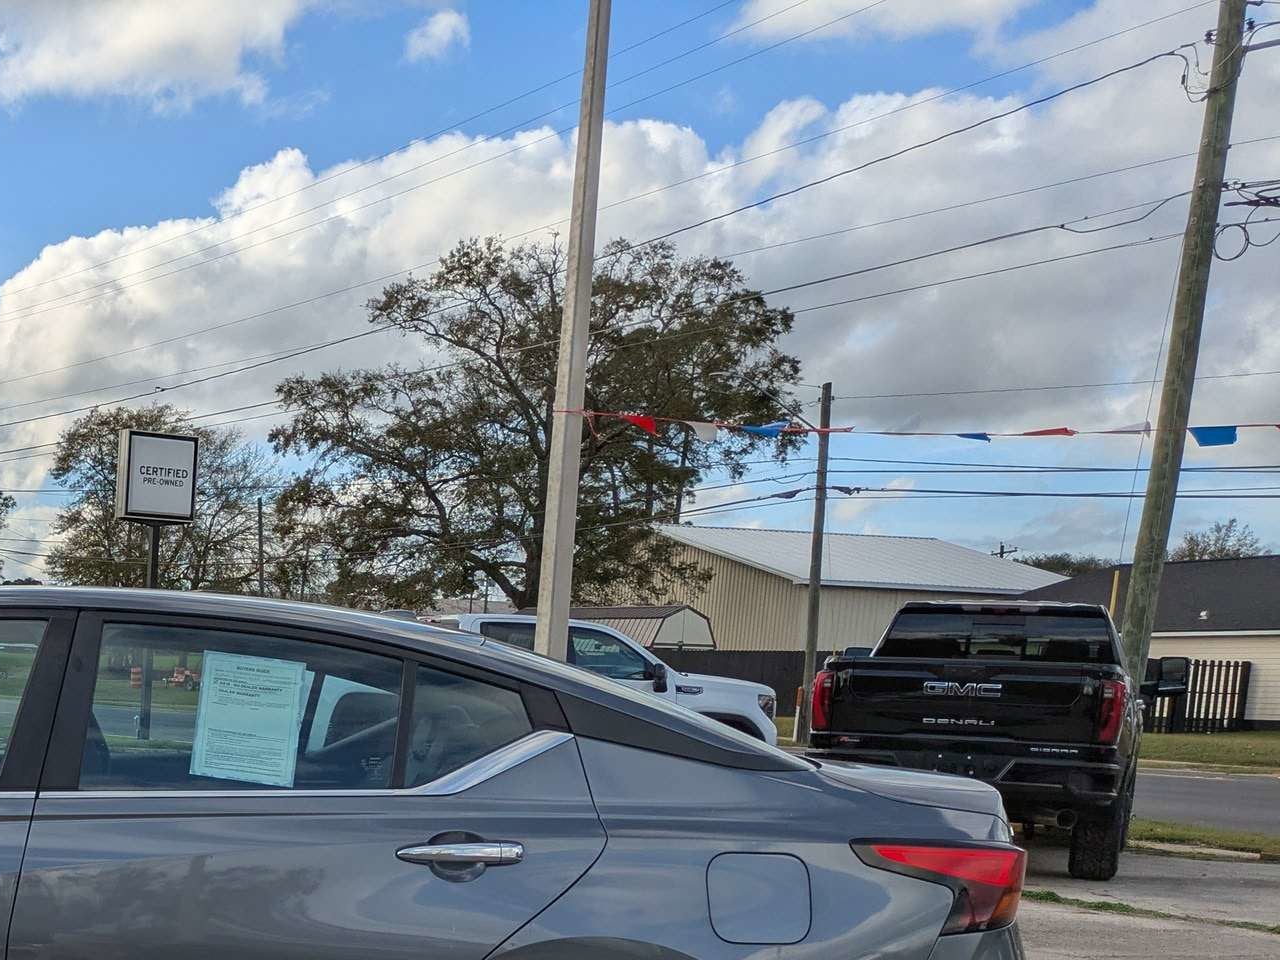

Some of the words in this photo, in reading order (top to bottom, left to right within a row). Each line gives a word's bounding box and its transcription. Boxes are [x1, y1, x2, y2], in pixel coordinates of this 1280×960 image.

[139, 465, 189, 479] CERTIFIED
[142, 476, 184, 488] PRE-OWNED
[923, 681, 1002, 698] GMC
[922, 717, 995, 726] DENALI
